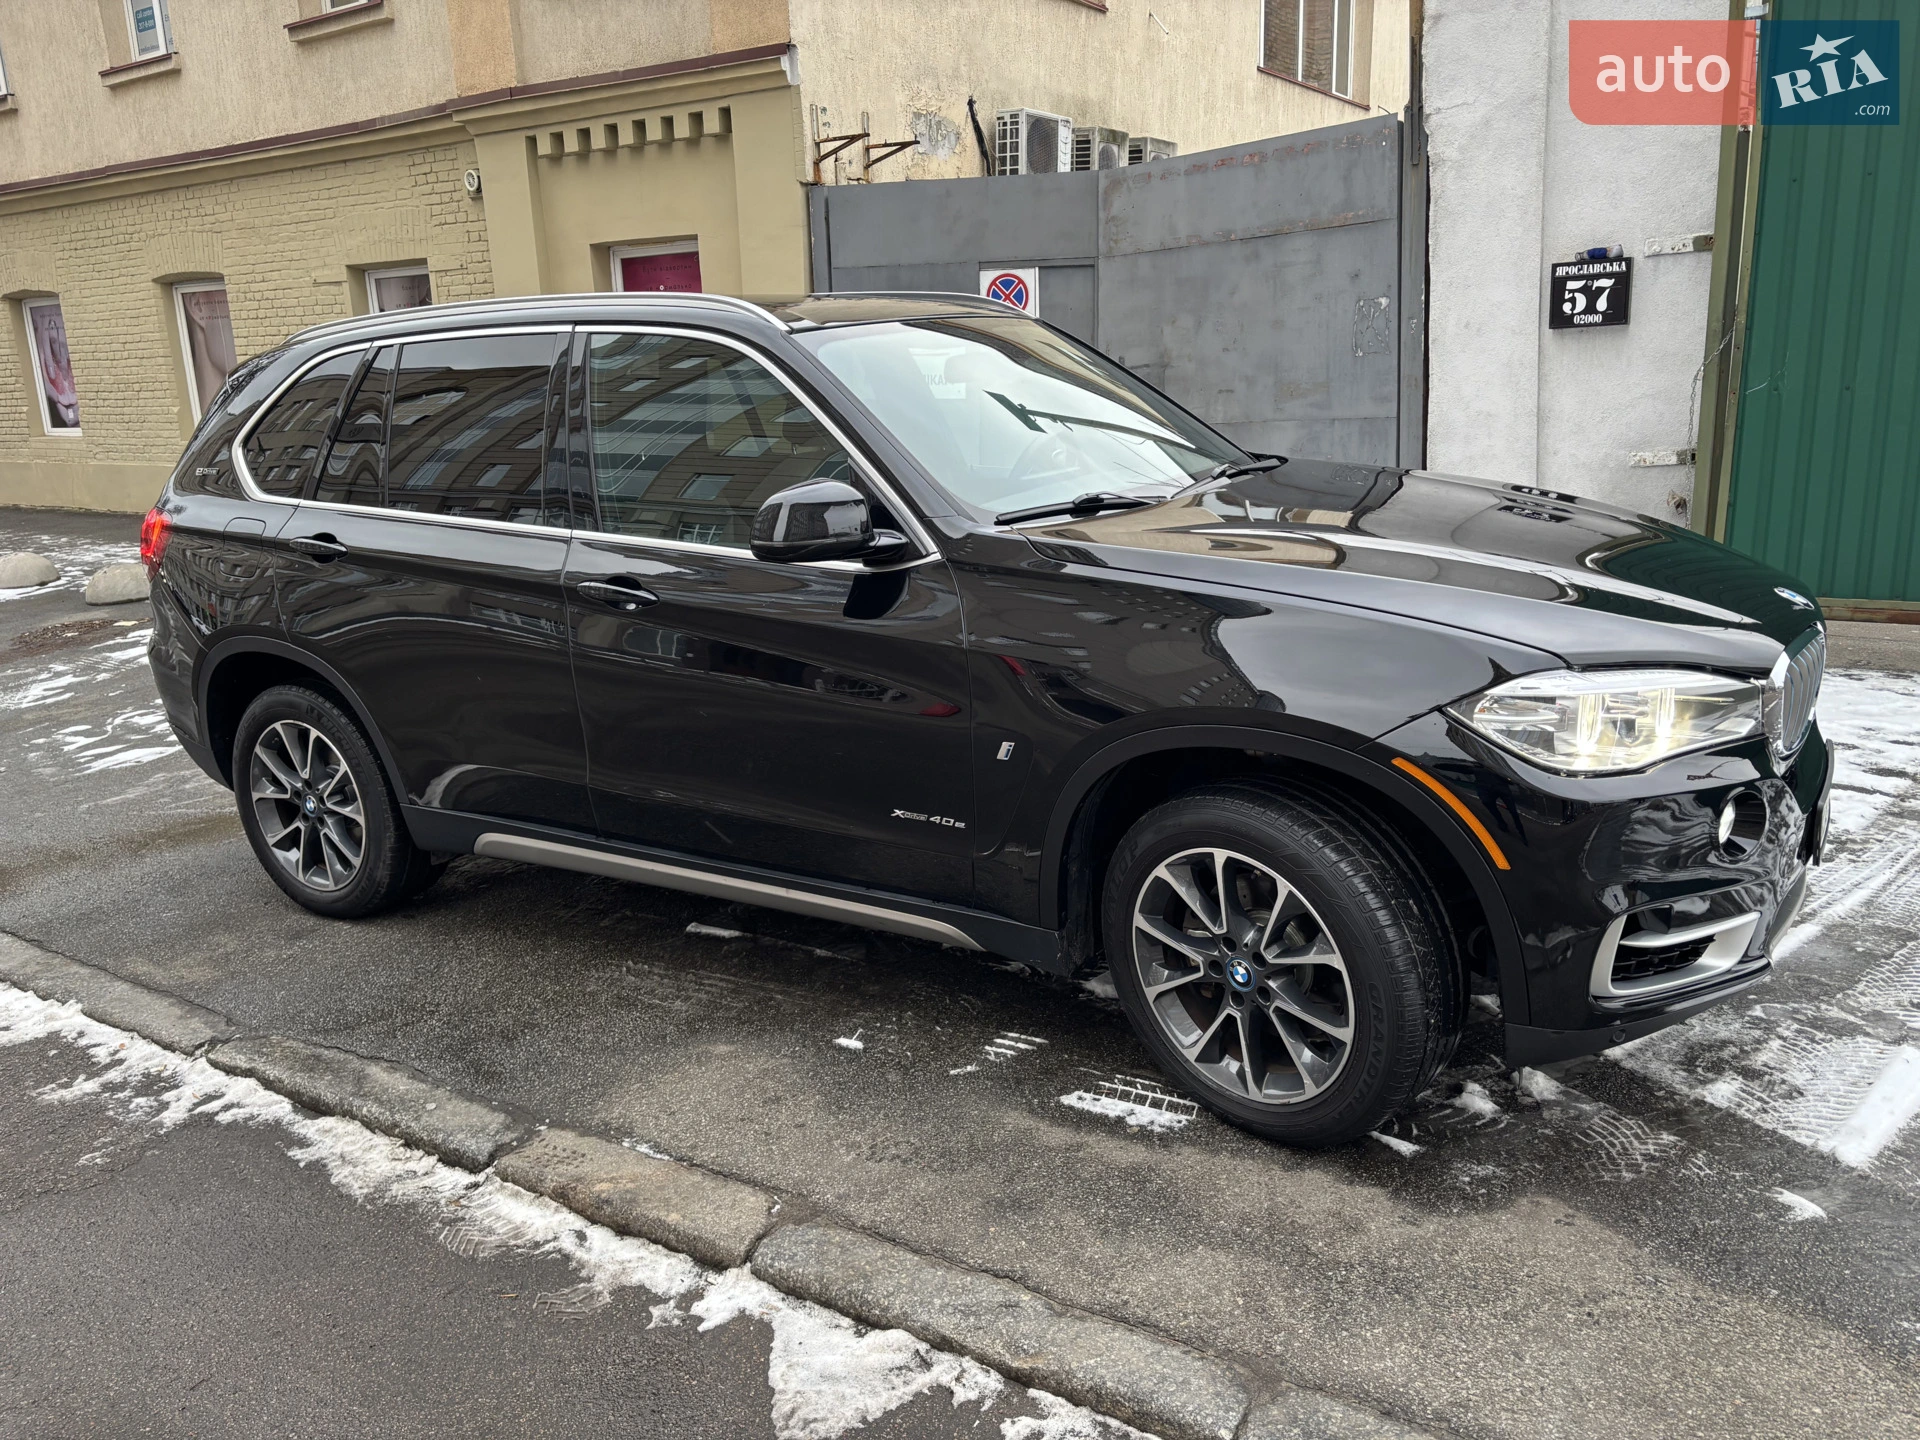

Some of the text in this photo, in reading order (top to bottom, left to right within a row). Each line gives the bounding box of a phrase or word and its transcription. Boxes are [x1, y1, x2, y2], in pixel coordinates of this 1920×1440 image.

[1555, 261, 1627, 276] ЯРОСЛАВСЬКА
[1562, 278, 1615, 314] 57
[1573, 313, 1603, 324] 02000
